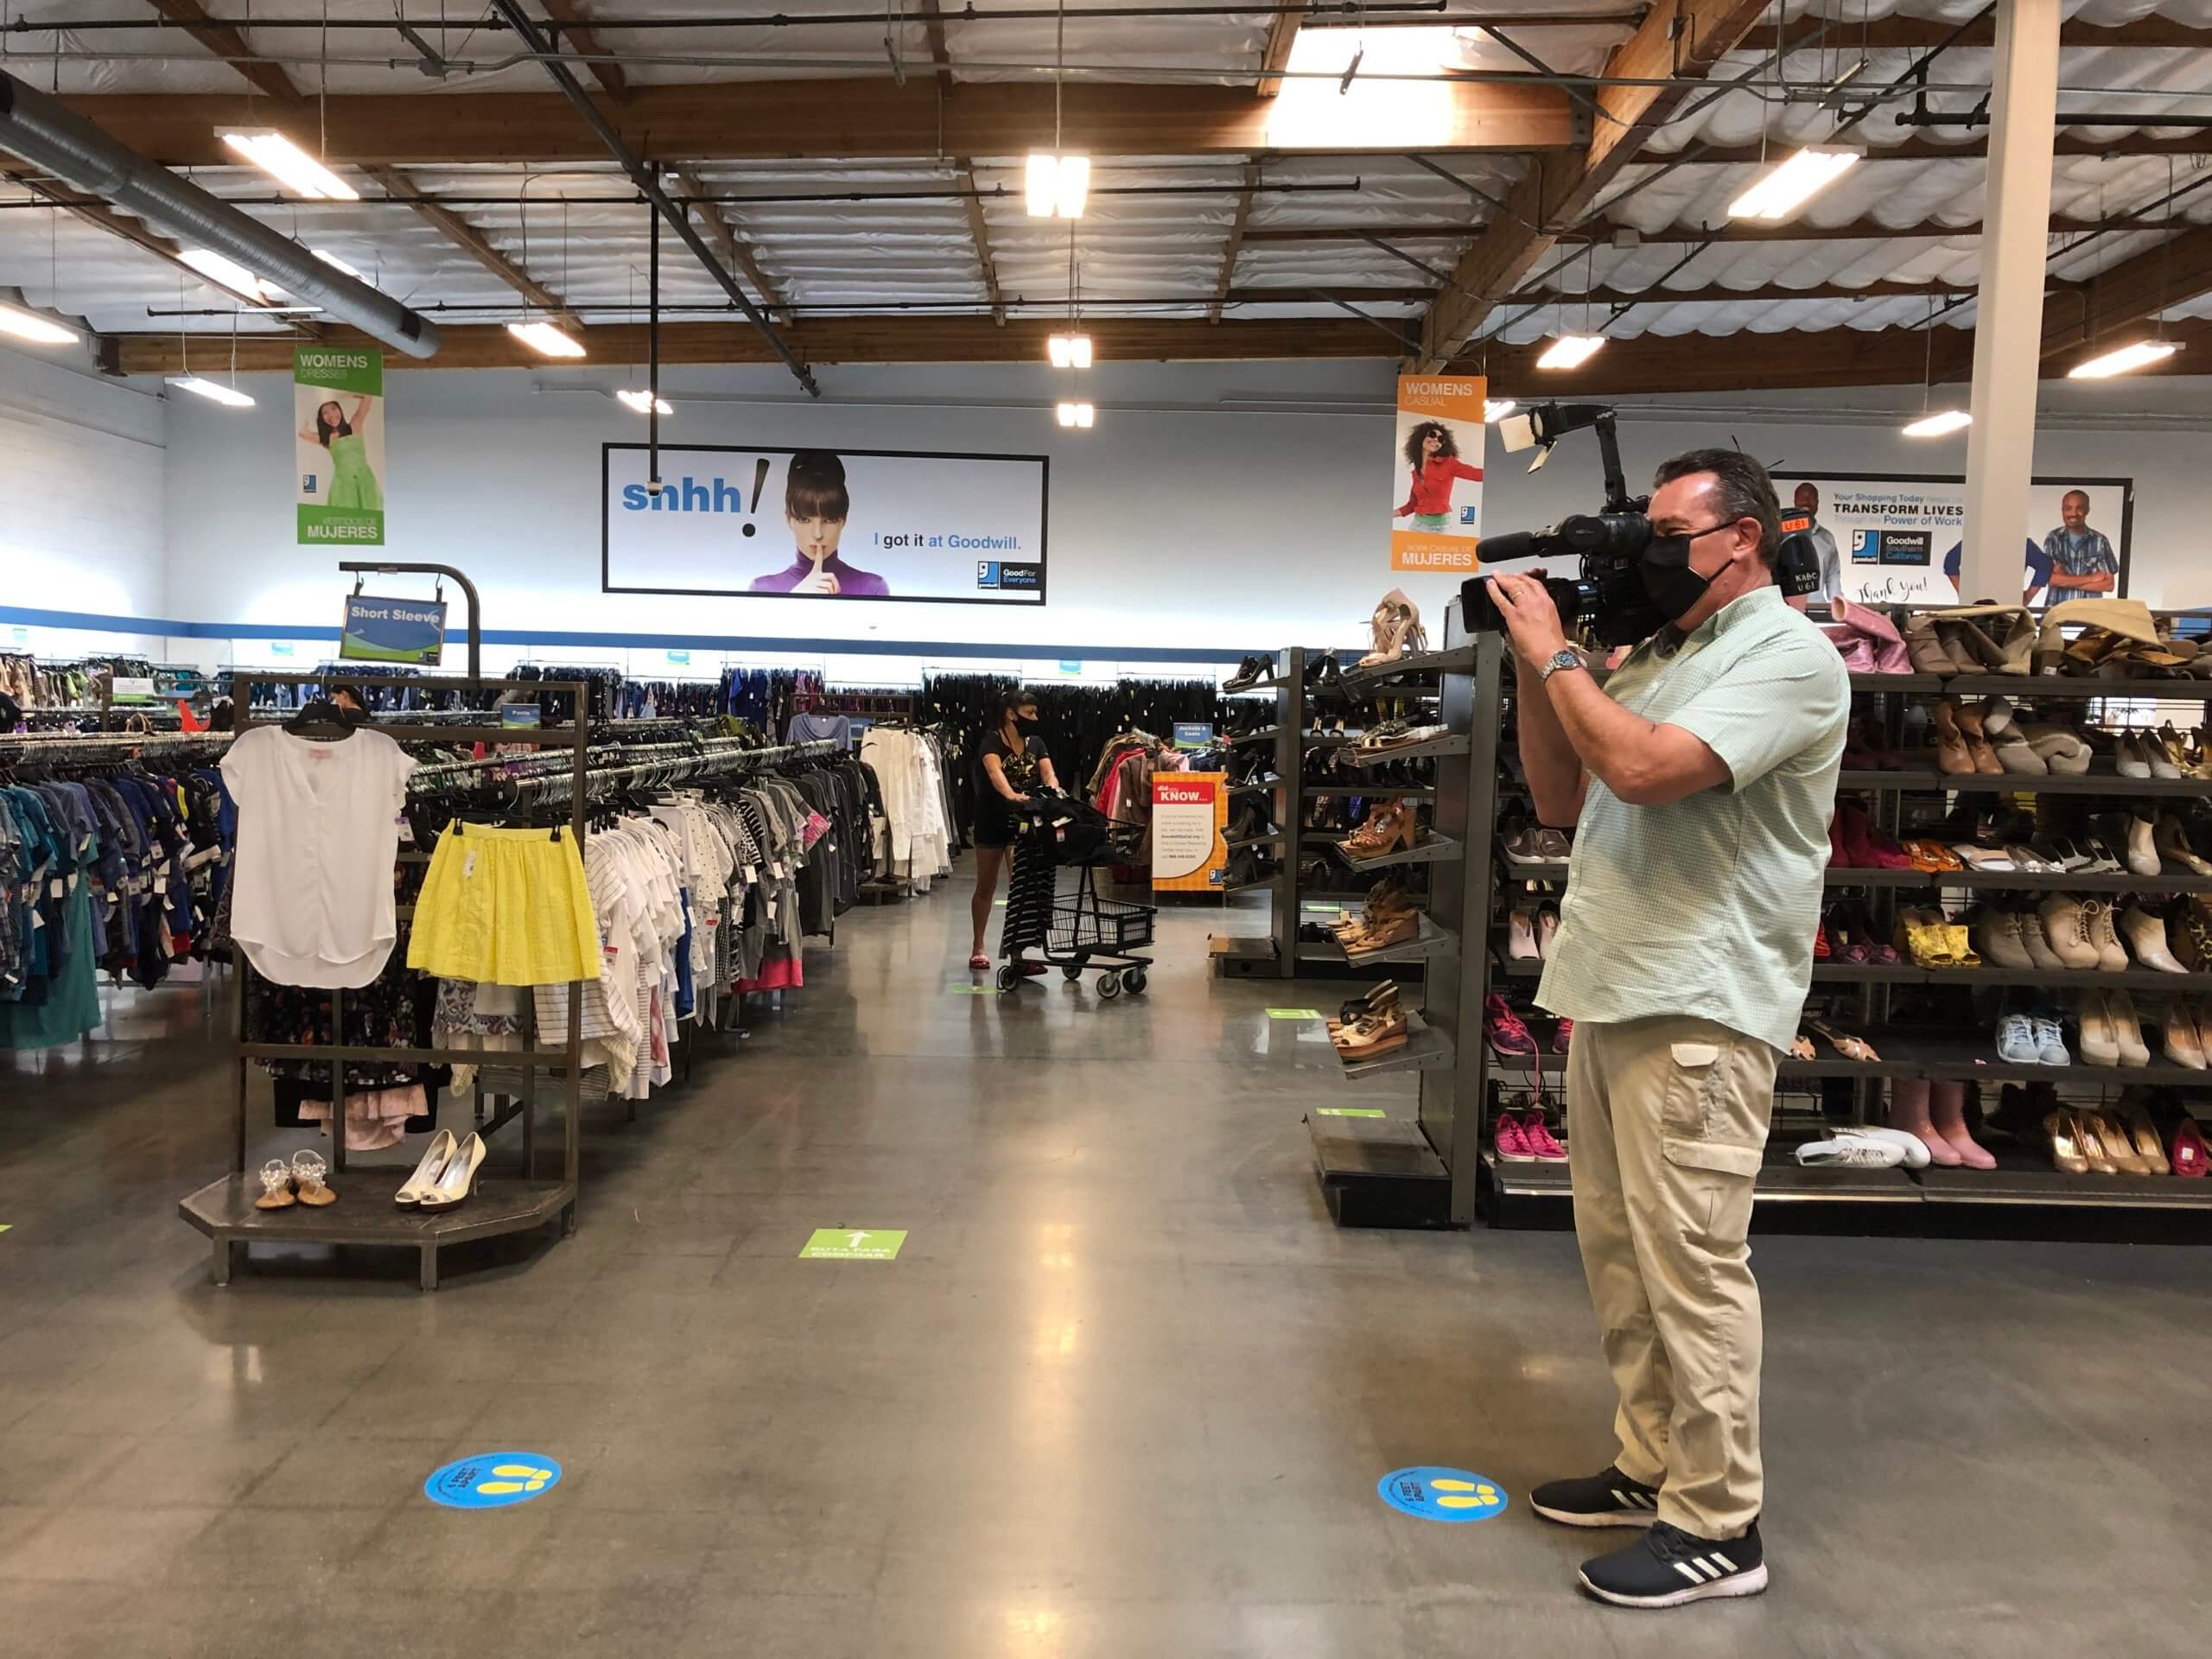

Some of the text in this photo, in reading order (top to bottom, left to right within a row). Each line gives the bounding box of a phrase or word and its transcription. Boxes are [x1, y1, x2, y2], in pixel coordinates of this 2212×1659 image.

[299, 354, 368, 368] WOMENS
[1406, 382, 1473, 396] WOMENS
[1406, 396, 1446, 407] CASUAL
[1834, 493, 1853, 501] Your
[1855, 493, 1897, 503] Shopping
[1899, 494, 1924, 504] Today
[1834, 504, 1964, 515] TRANSFORM LIVES
[1884, 515, 1917, 525] Power
[1921, 516, 1932, 525] of
[1935, 516, 1962, 525] Work
[307, 524, 378, 539] MUJERES
[874, 532, 1021, 550] I got it at Goodwill.
[1886, 536, 1924, 545] Goodwill
[1402, 552, 1472, 566] MUJERES
[1796, 572, 1818, 582] KABC
[352, 606, 440, 623] Short Sleeve
